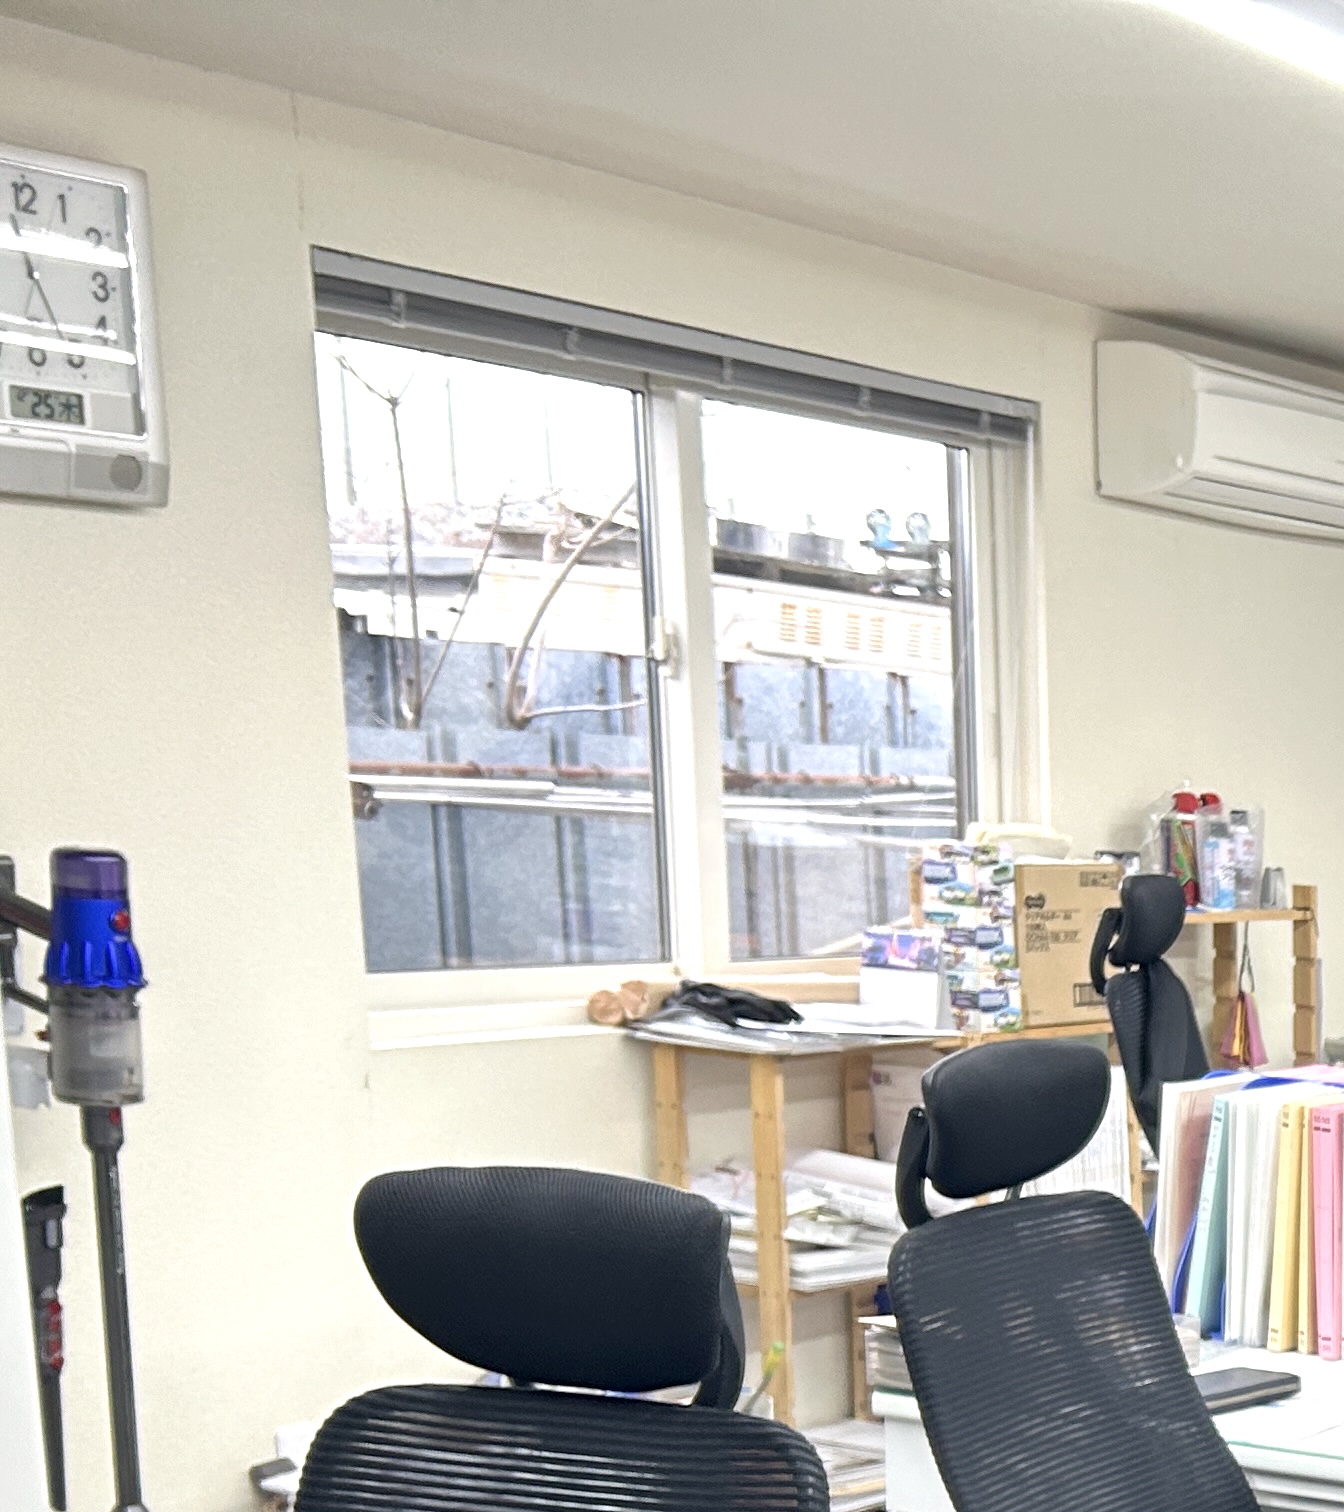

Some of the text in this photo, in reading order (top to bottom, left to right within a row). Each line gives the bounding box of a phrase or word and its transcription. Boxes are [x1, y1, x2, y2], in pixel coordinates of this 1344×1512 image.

[11, 181, 37, 215] 12
[57, 193, 67, 223] 1
[91, 271, 110, 302] 3
